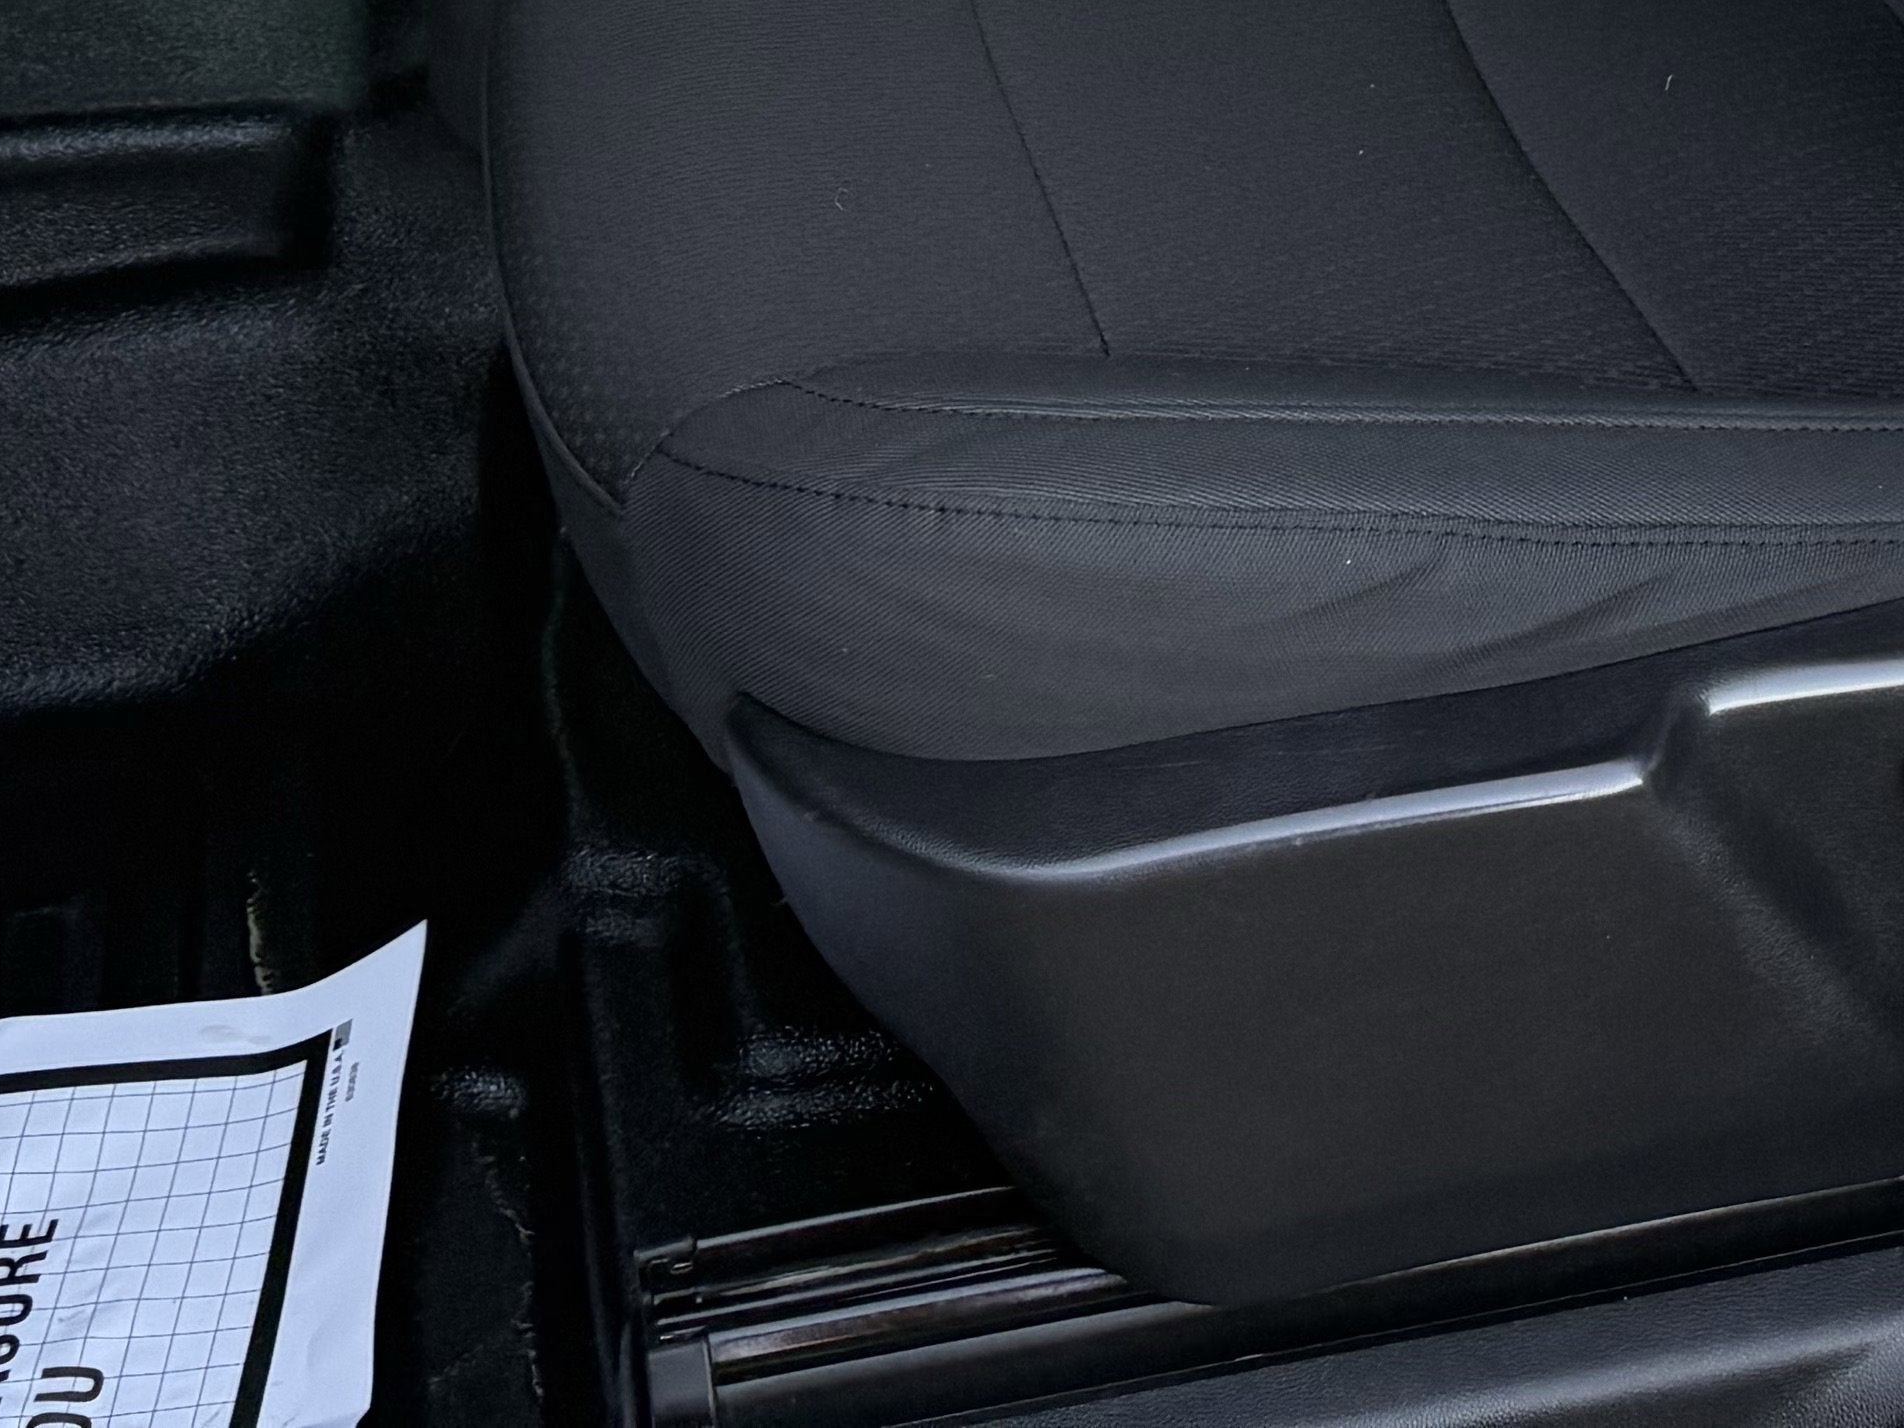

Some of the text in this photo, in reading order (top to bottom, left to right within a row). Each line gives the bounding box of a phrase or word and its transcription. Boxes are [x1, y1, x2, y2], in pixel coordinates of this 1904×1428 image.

[325, 1087, 338, 1112] THE
[322, 1113, 334, 1129] IN
[316, 1129, 331, 1165] MADE
